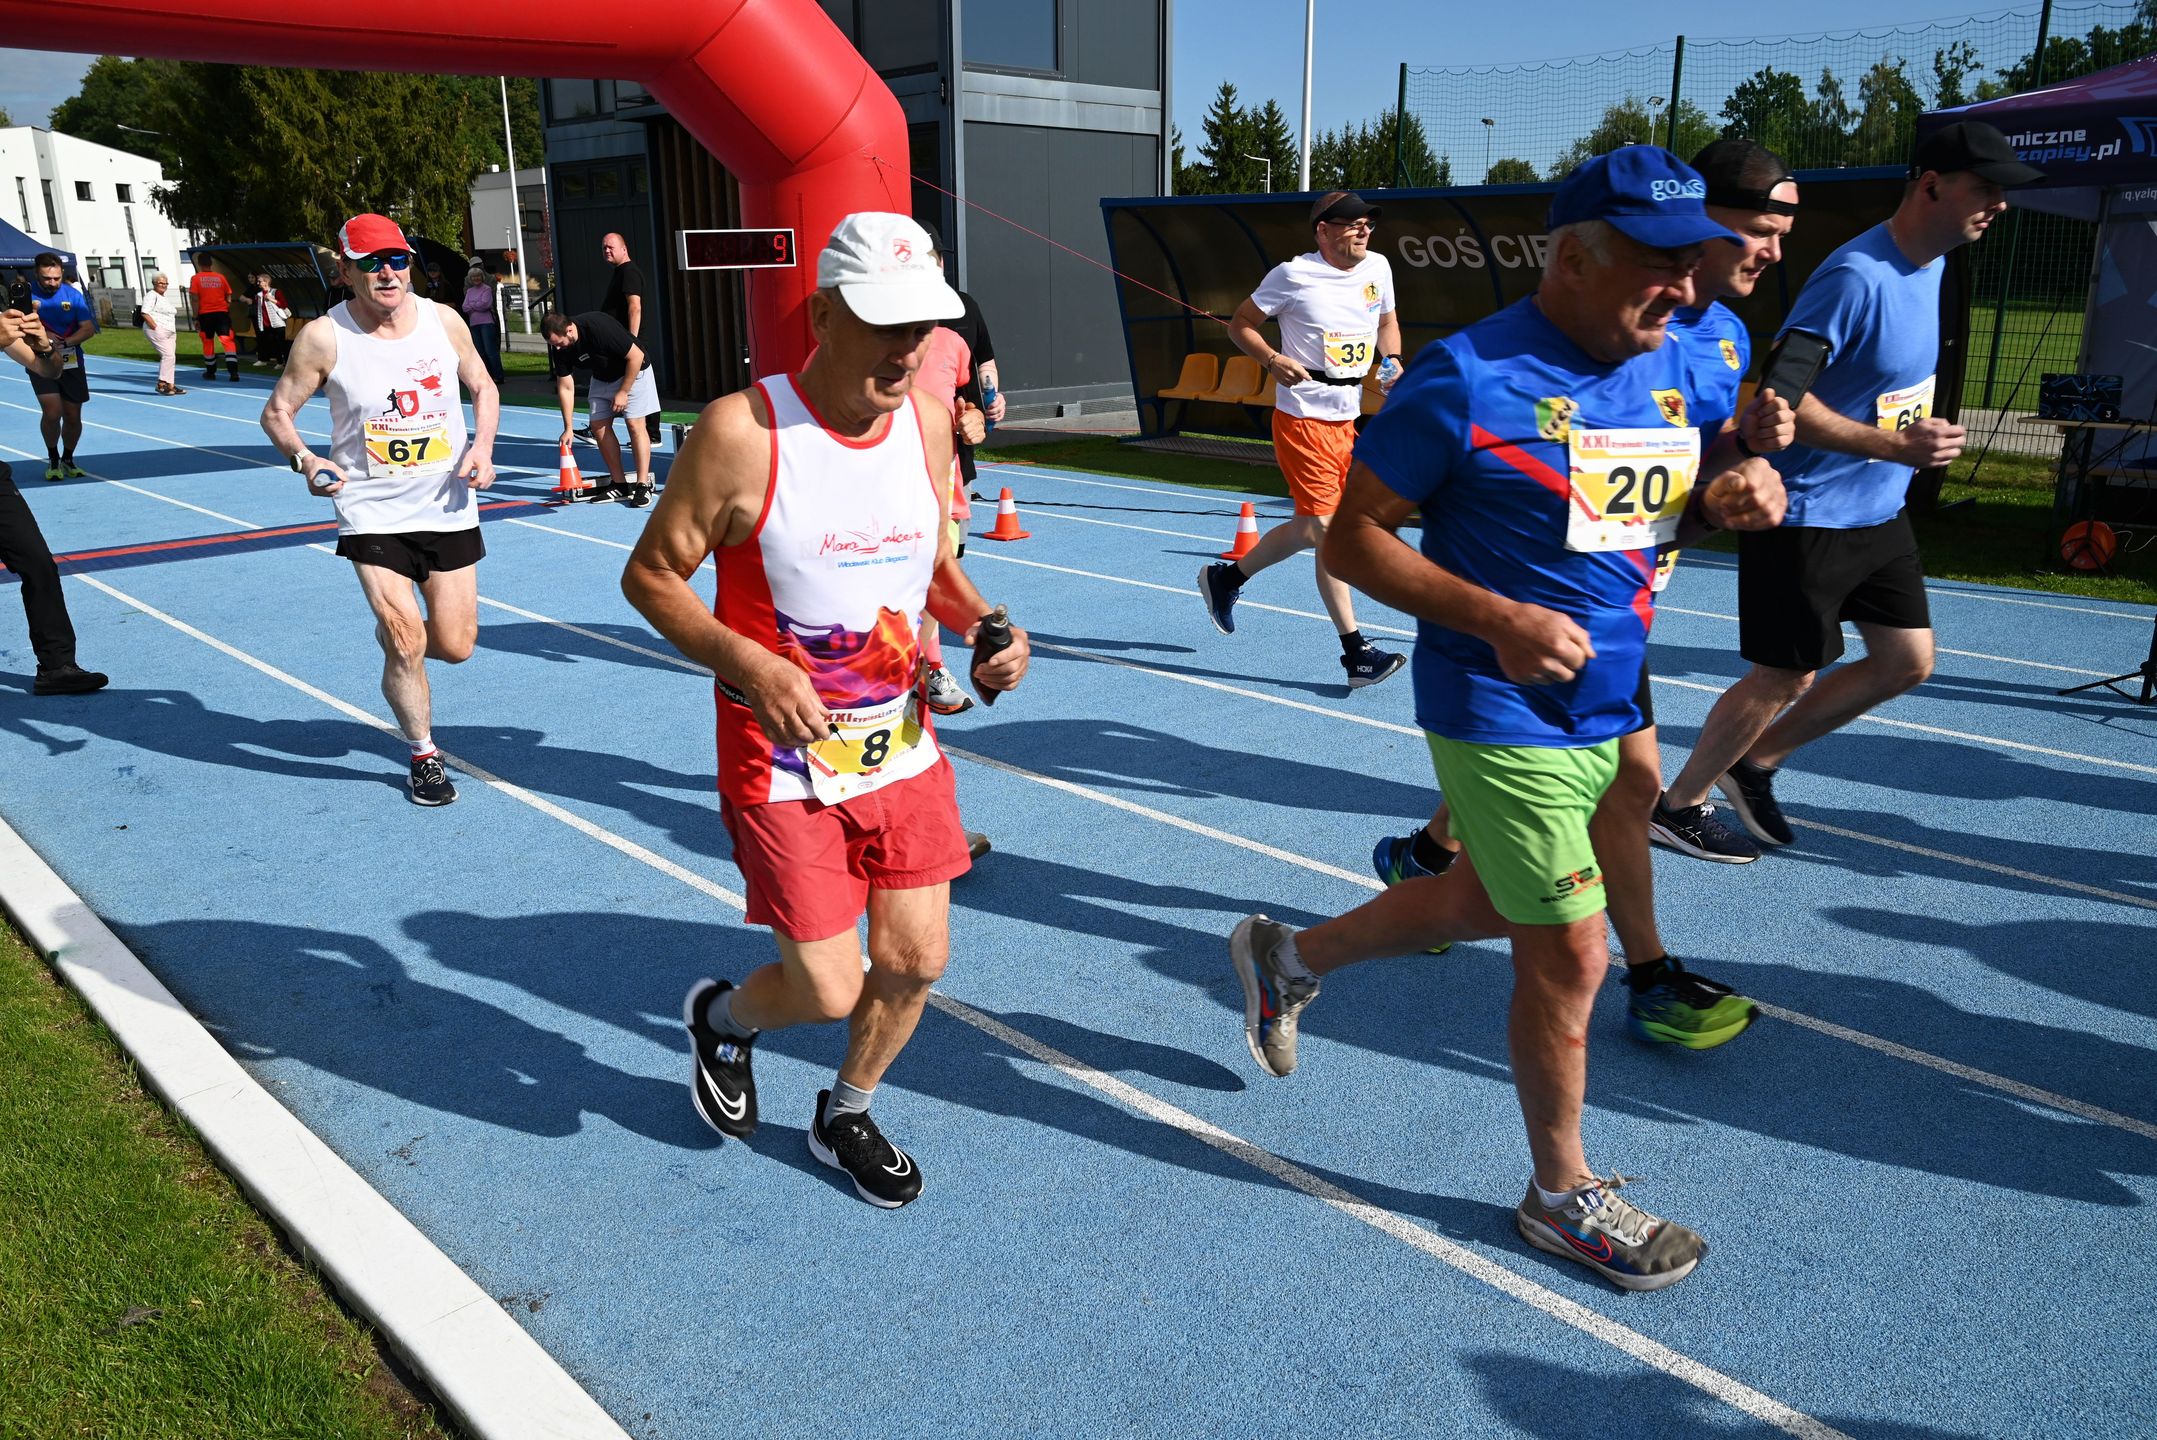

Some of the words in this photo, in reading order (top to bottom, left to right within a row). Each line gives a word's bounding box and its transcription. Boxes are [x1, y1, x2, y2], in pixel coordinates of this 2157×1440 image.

[773, 234, 787, 262] 9
[1341, 342, 1366, 364] 33
[371, 423, 389, 431] XXI
[388, 436, 431, 463] 67
[1582, 435, 1609, 449] XXI
[1605, 465, 1670, 515] 20
[1356, 665, 1373, 673] HOKA
[860, 729, 891, 767] 8
